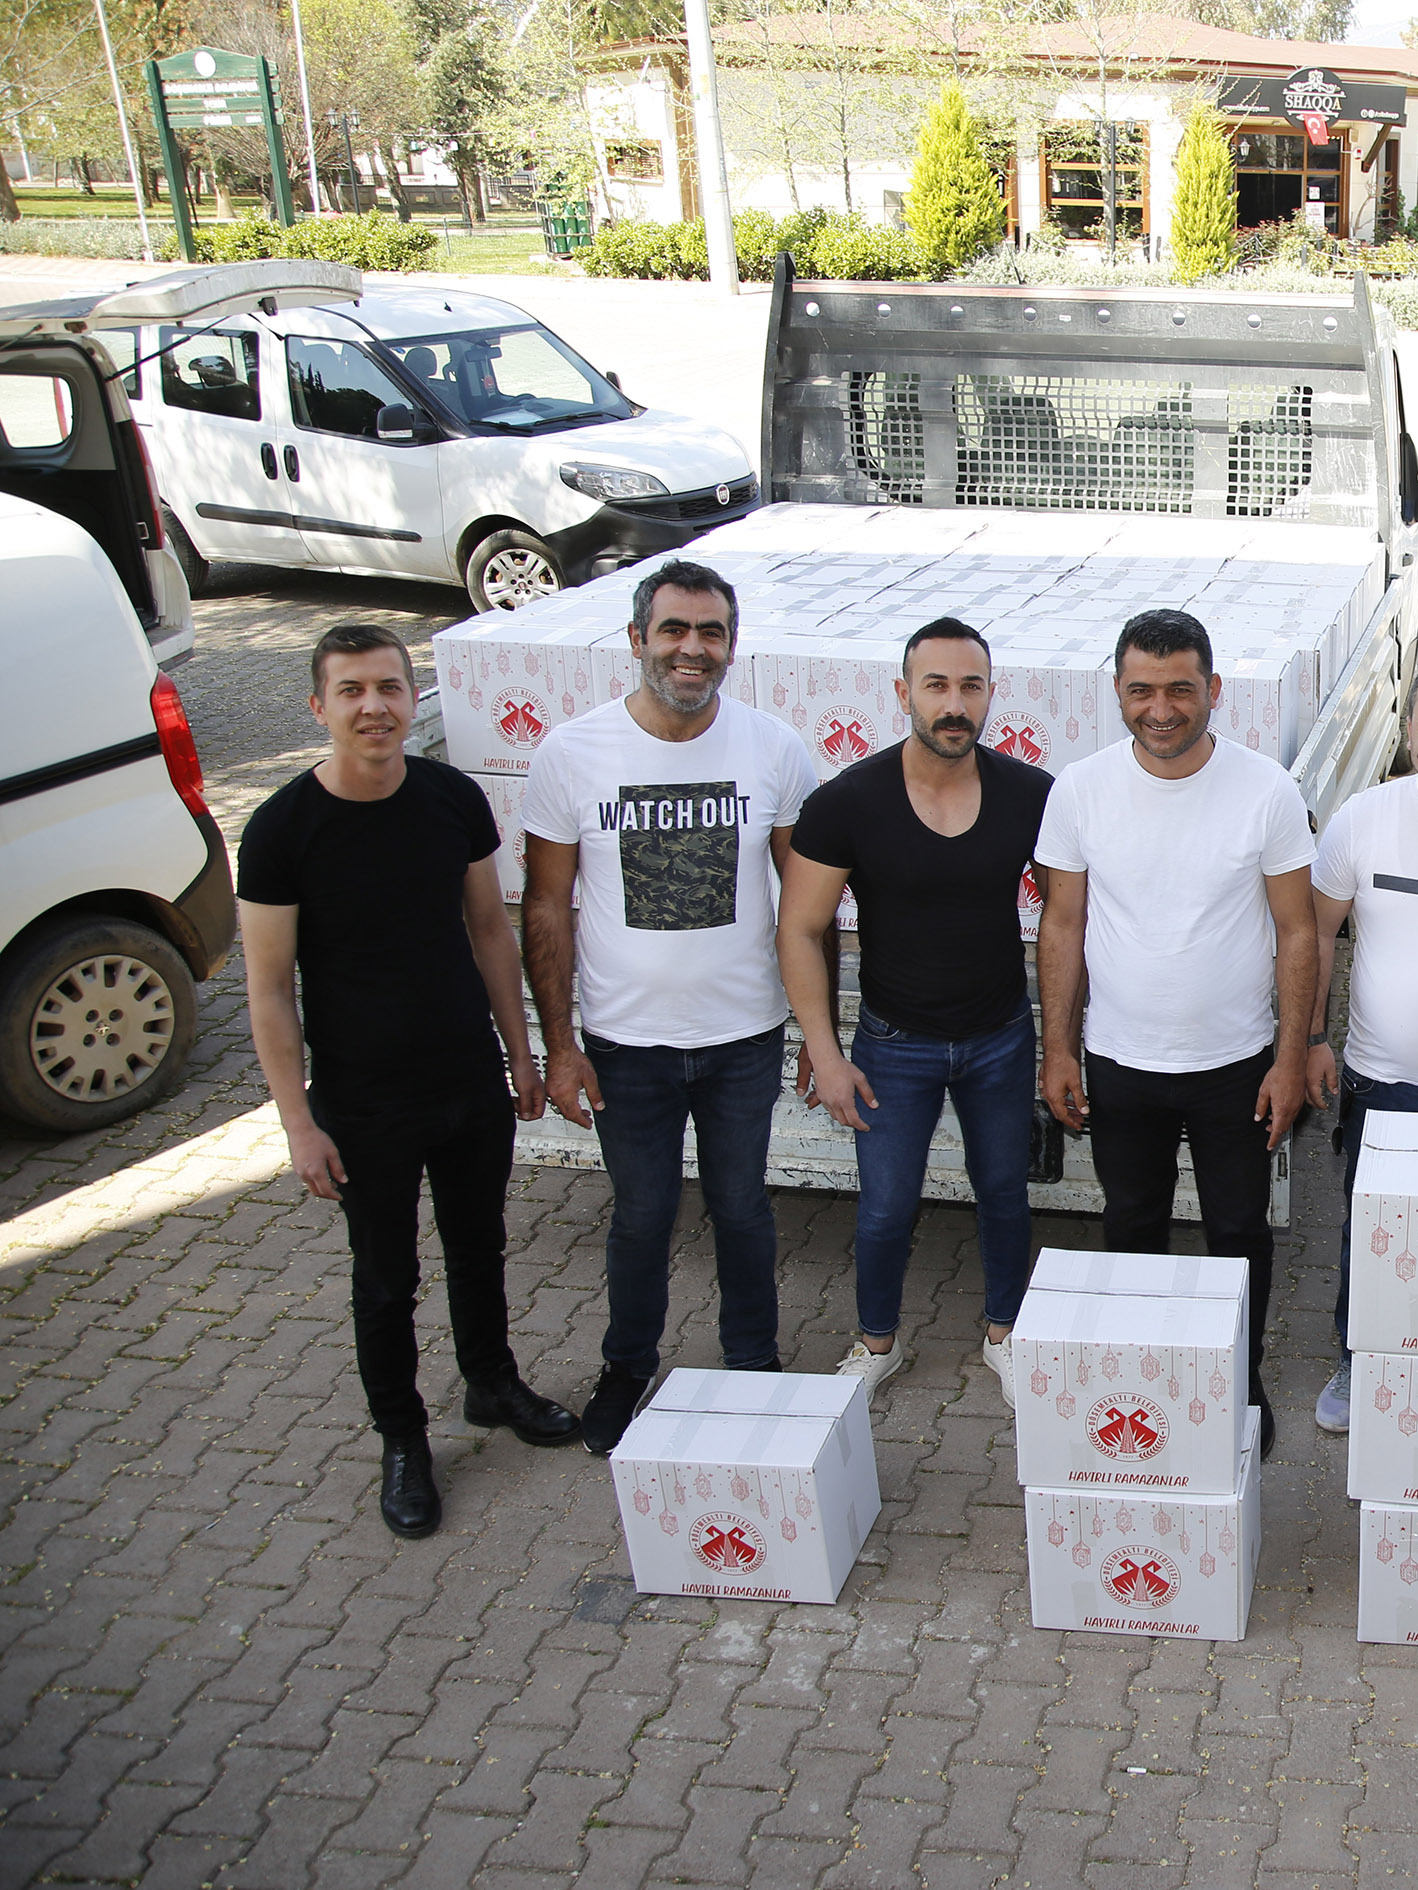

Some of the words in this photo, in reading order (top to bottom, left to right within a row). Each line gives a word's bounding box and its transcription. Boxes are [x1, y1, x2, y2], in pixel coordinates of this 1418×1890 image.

[1285, 94, 1342, 114] SHAQQA
[484, 758, 514, 770] HAYIRLI
[599, 799, 694, 830] WATCH
[702, 796, 750, 827] OUT
[1068, 1471, 1112, 1483] HAYIRLI
[1114, 1473, 1189, 1487] RAMAZANLAR
[681, 1584, 720, 1595] HAYIRLI
[724, 1586, 792, 1599] RAMAZANLAR
[1084, 1617, 1125, 1629] HAYIRLI
[1128, 1620, 1200, 1634] RAMAZANLAR
